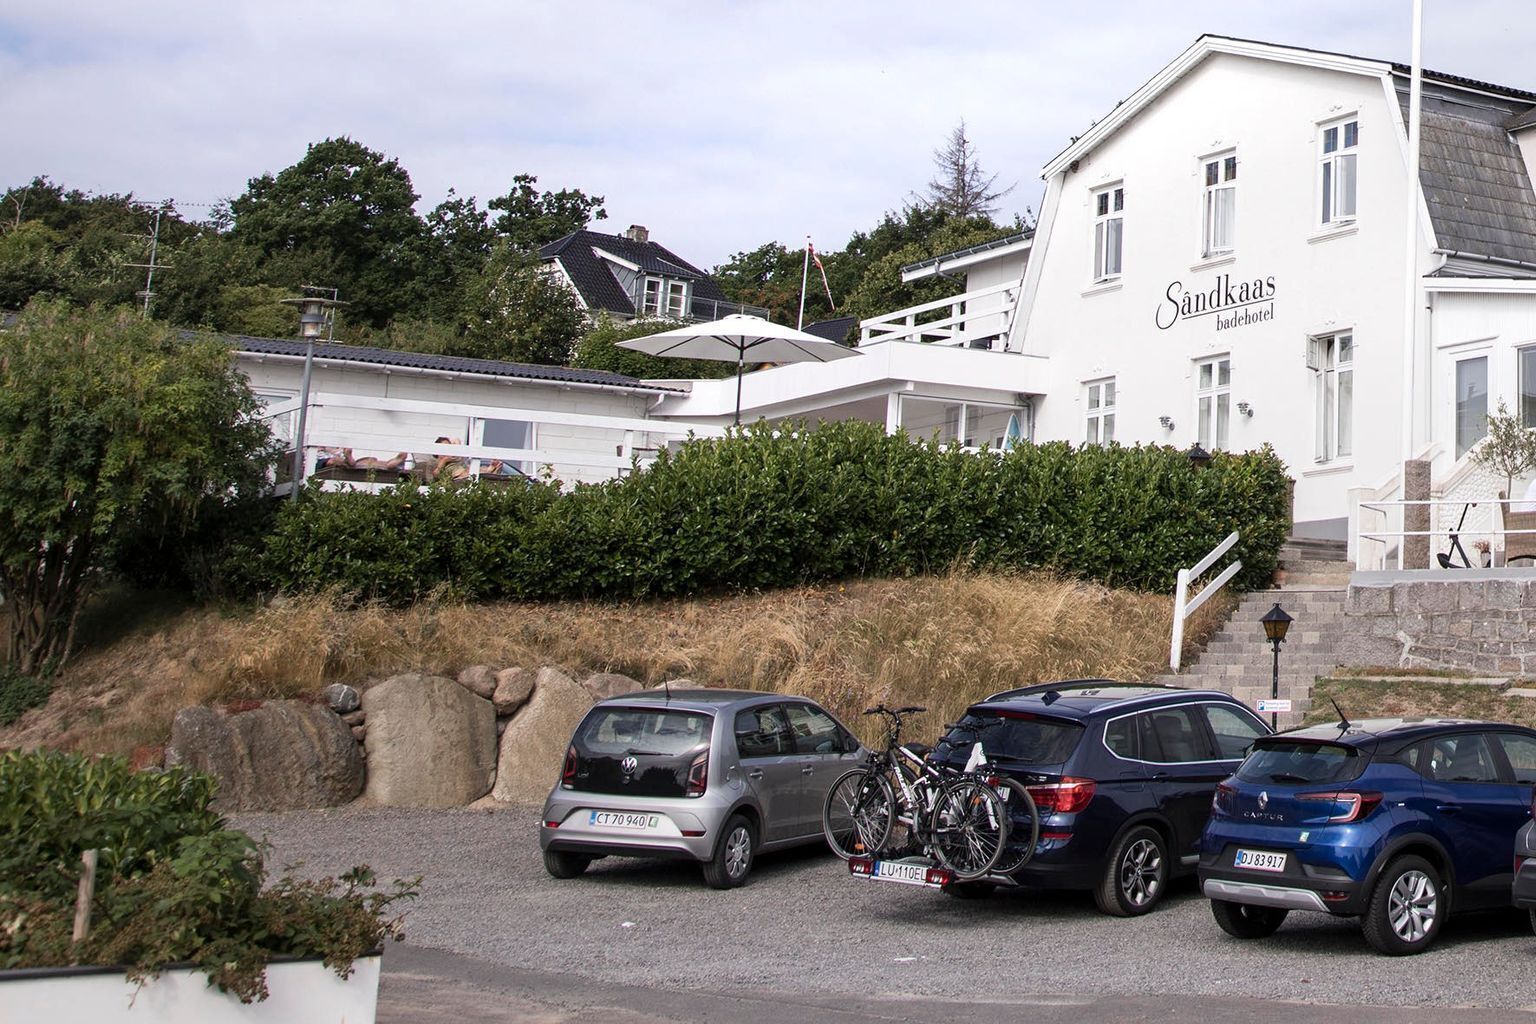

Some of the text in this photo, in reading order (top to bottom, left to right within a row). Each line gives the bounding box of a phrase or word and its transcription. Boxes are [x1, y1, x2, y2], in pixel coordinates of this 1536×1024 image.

[1155, 274, 1276, 330] Sândkaas
[1216, 302, 1274, 331] badehotel
[596, 813, 646, 827] CT 70 940
[1243, 811, 1284, 822] CAPTUR
[1241, 853, 1284, 868] DJ 83 917
